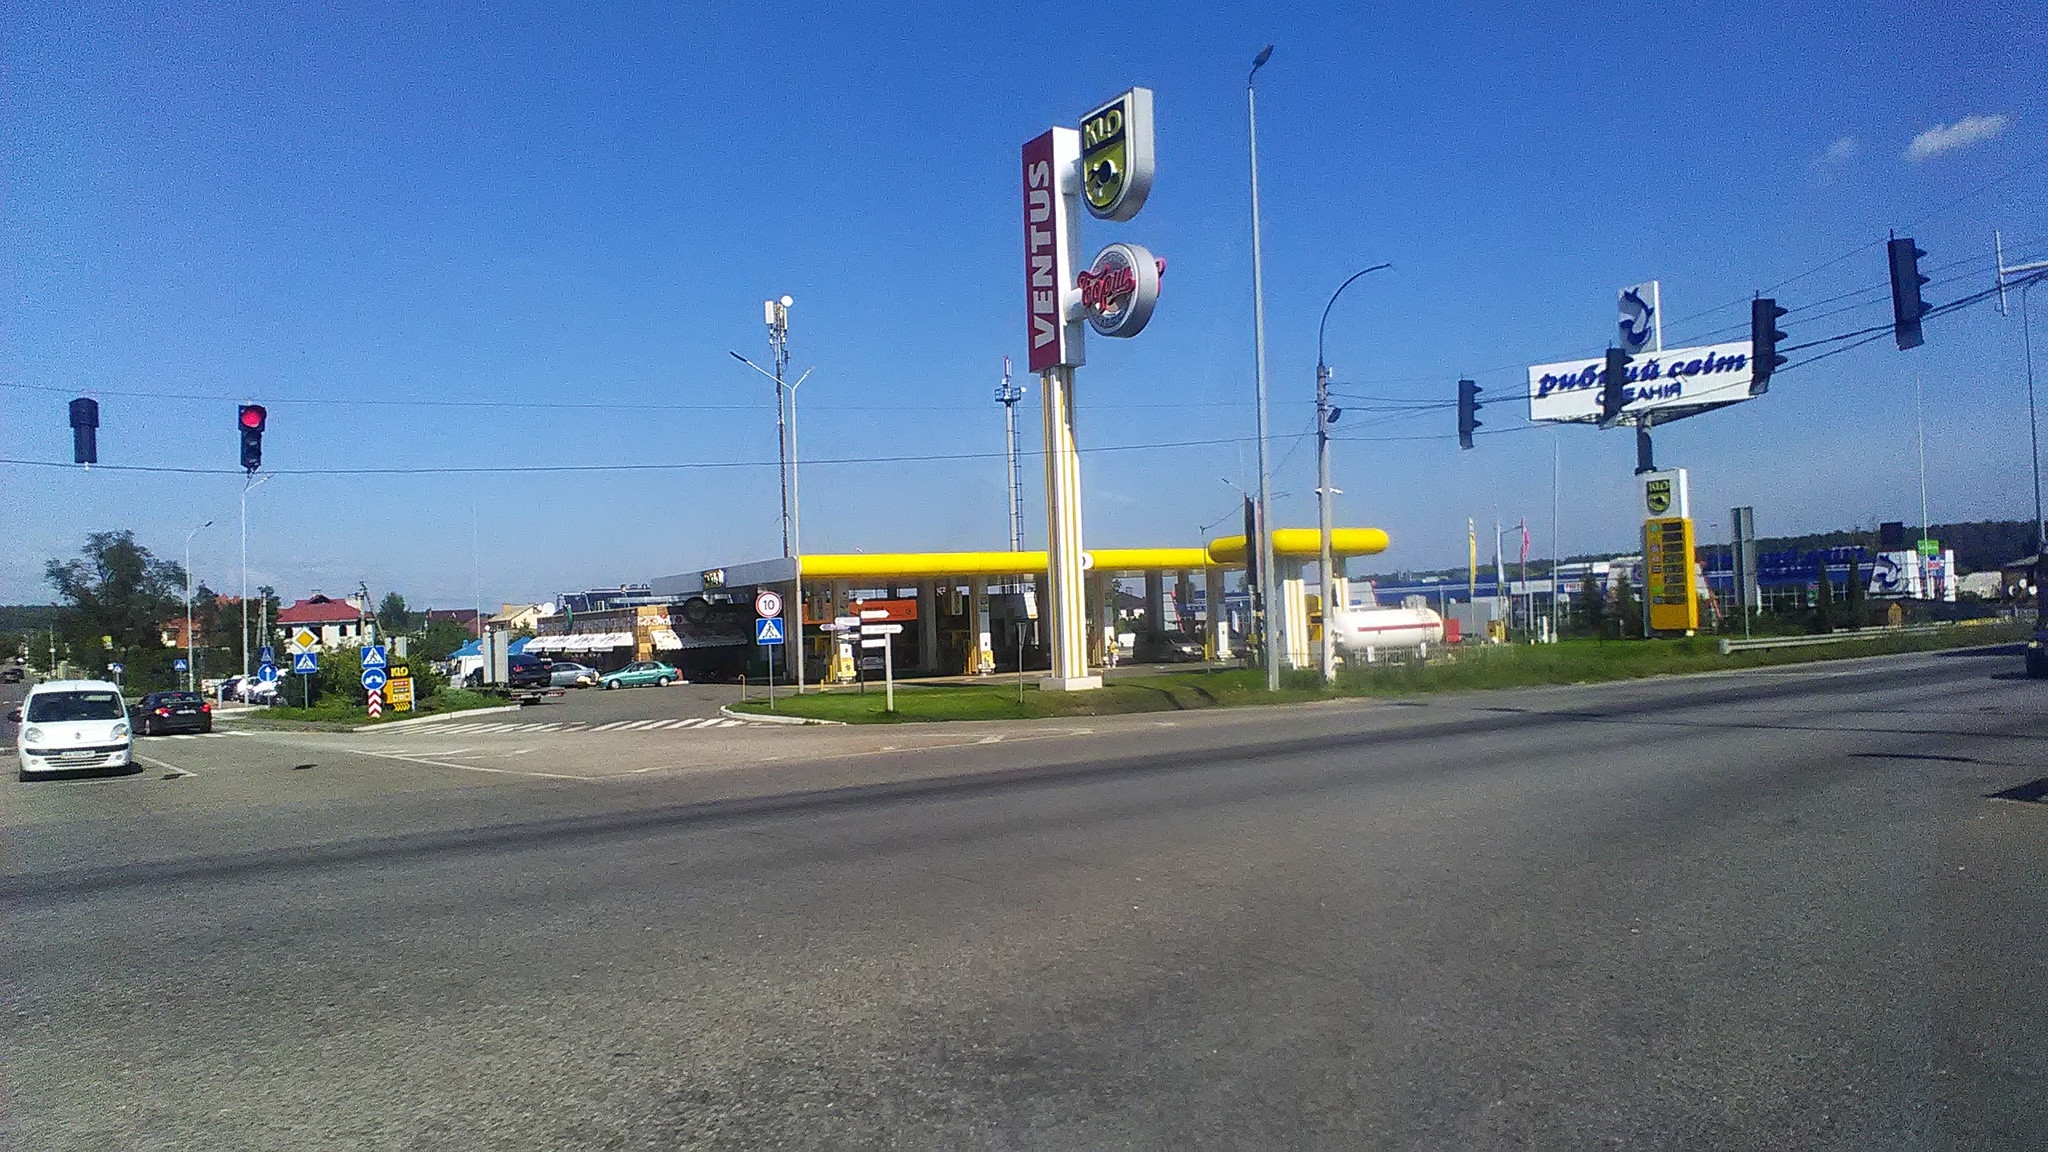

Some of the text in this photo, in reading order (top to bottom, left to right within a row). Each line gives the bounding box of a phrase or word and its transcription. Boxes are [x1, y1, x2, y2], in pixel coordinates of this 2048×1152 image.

[1084, 108, 1123, 150] KLO
[1028, 159, 1055, 350] VENTUS
[1595, 381, 1683, 406] ОЕАНІЯ
[763, 599, 775, 611] 10
[390, 666, 409, 677] KLO
